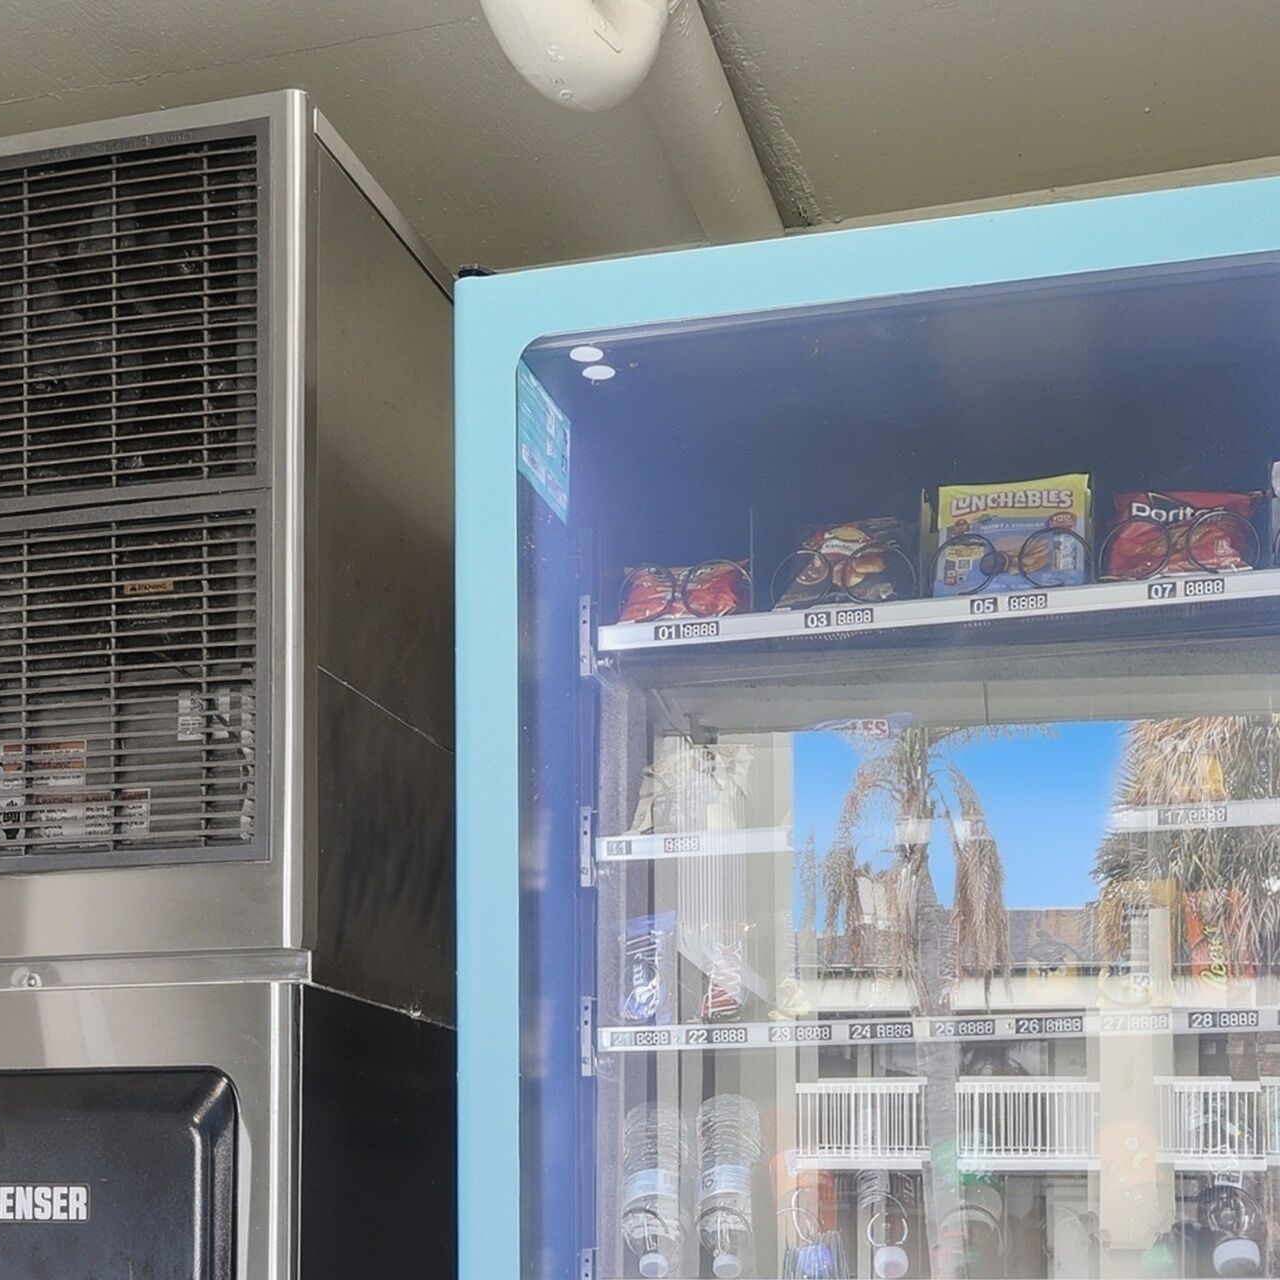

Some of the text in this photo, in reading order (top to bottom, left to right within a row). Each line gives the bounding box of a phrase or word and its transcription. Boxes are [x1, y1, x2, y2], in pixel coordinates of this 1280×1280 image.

[951, 489, 1073, 518] LUNCHABLES
[1151, 585, 1174, 599] 07
[807, 614, 828, 627] 03
[658, 626, 676, 640] 01
[1019, 1019, 1039, 1033] 26
[1103, 1018, 1124, 1030] 27
[1193, 1014, 1212, 1027] 28
[688, 1031, 708, 1044] 22
[851, 1026, 872, 1039] 24
